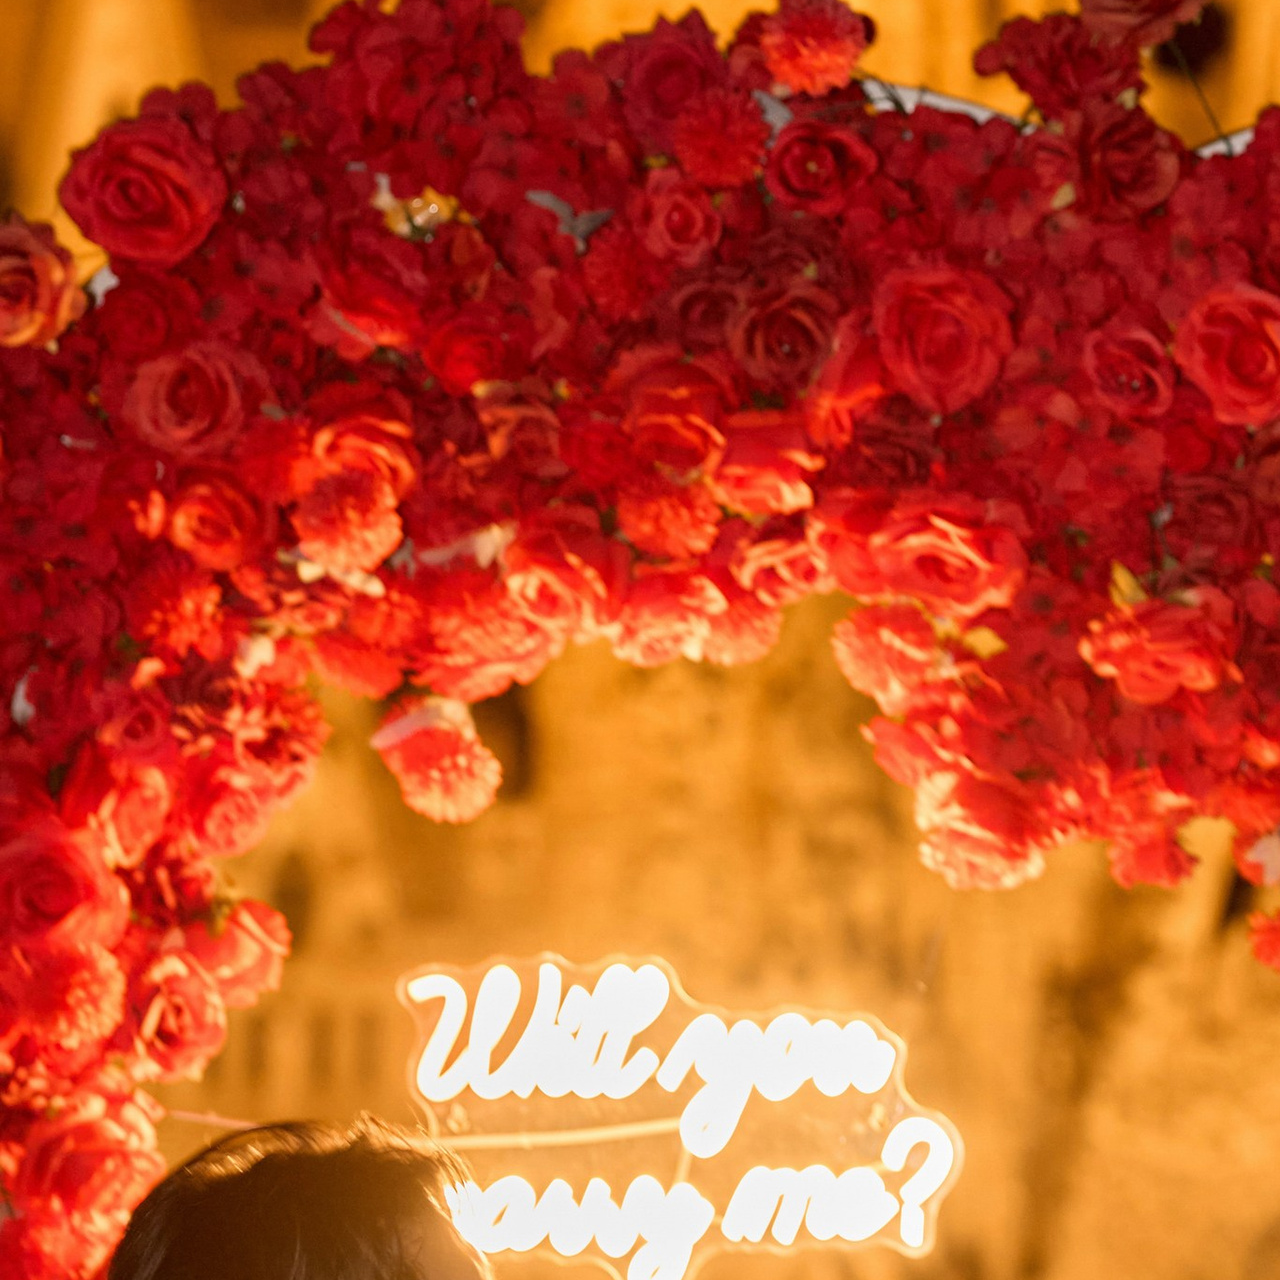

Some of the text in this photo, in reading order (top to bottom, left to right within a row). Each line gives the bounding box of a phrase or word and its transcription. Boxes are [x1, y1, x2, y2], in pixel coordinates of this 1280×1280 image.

[410, 963, 896, 1159] Will you
[721, 1116, 954, 1248] me?
